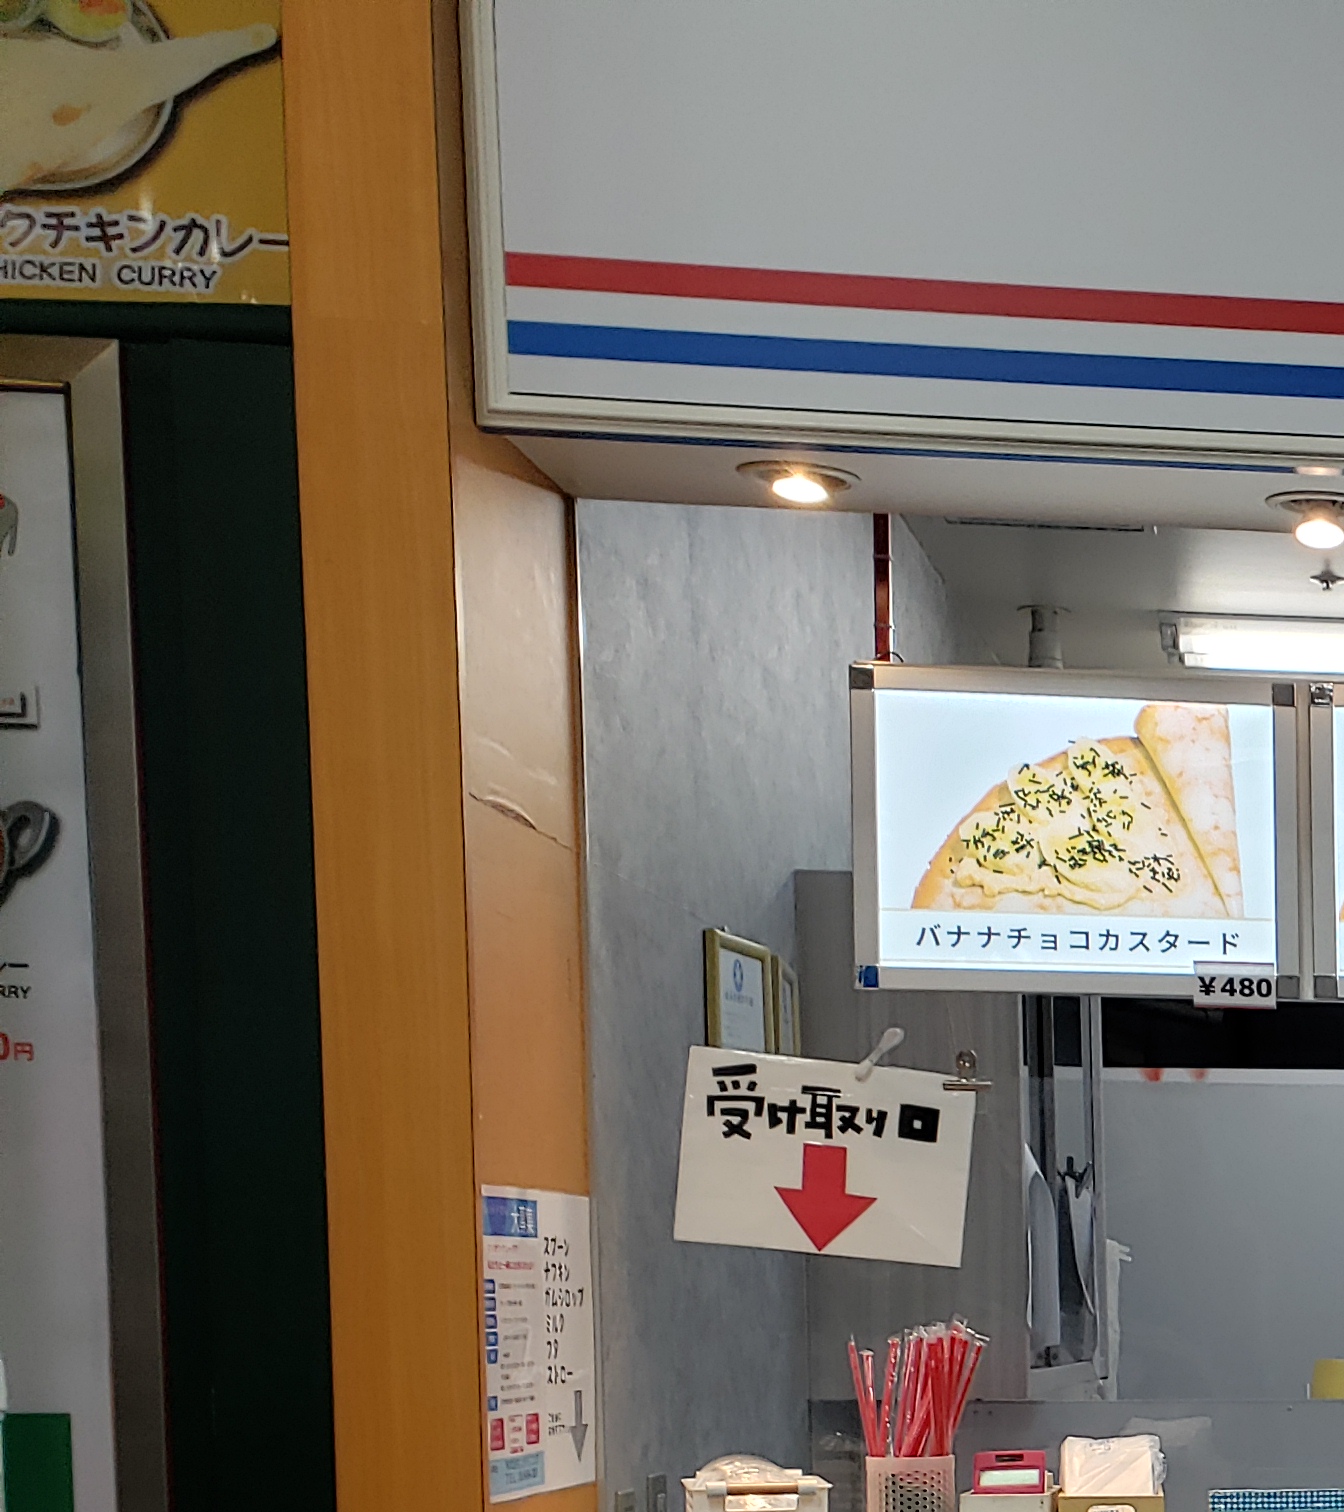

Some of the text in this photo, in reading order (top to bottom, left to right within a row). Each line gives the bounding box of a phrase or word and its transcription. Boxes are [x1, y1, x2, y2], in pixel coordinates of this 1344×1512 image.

[117, 262, 218, 289] CURRY
[915, 922, 1241, 957] バナナチョコカスタード
[1199, 974, 1274, 1000] ¥480
[706, 1063, 940, 1143] 受け取り口
[547, 1365, 573, 1385] ストロー
